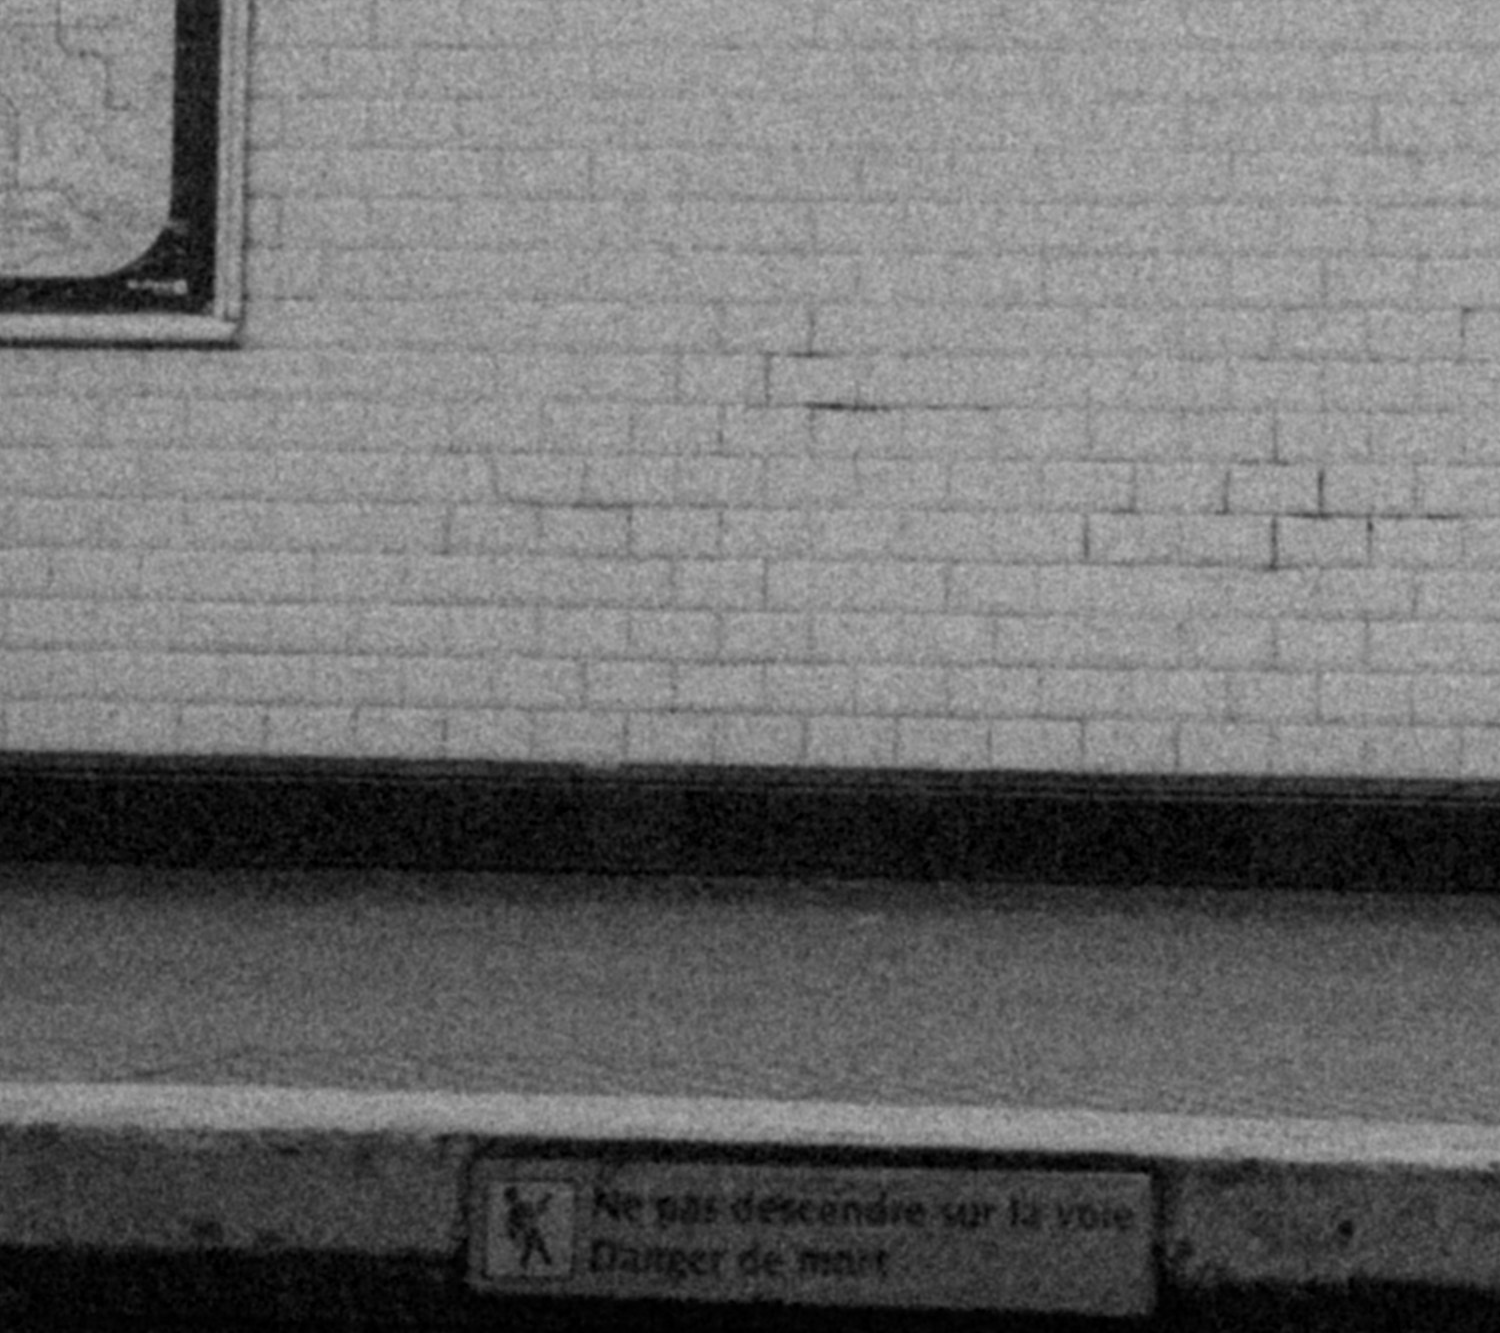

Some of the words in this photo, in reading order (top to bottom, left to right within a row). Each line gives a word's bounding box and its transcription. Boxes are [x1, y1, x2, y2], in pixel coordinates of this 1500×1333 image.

[594, 1188, 644, 1224] Ne
[655, 1195, 718, 1232] pas
[730, 1188, 927, 1228] descendre
[941, 1198, 994, 1228] sur
[1009, 1197, 1044, 1230] la
[1056, 1198, 1135, 1234] voie
[591, 1240, 722, 1281] Danger
[737, 1243, 784, 1277] de
[800, 1246, 890, 1279] mort
